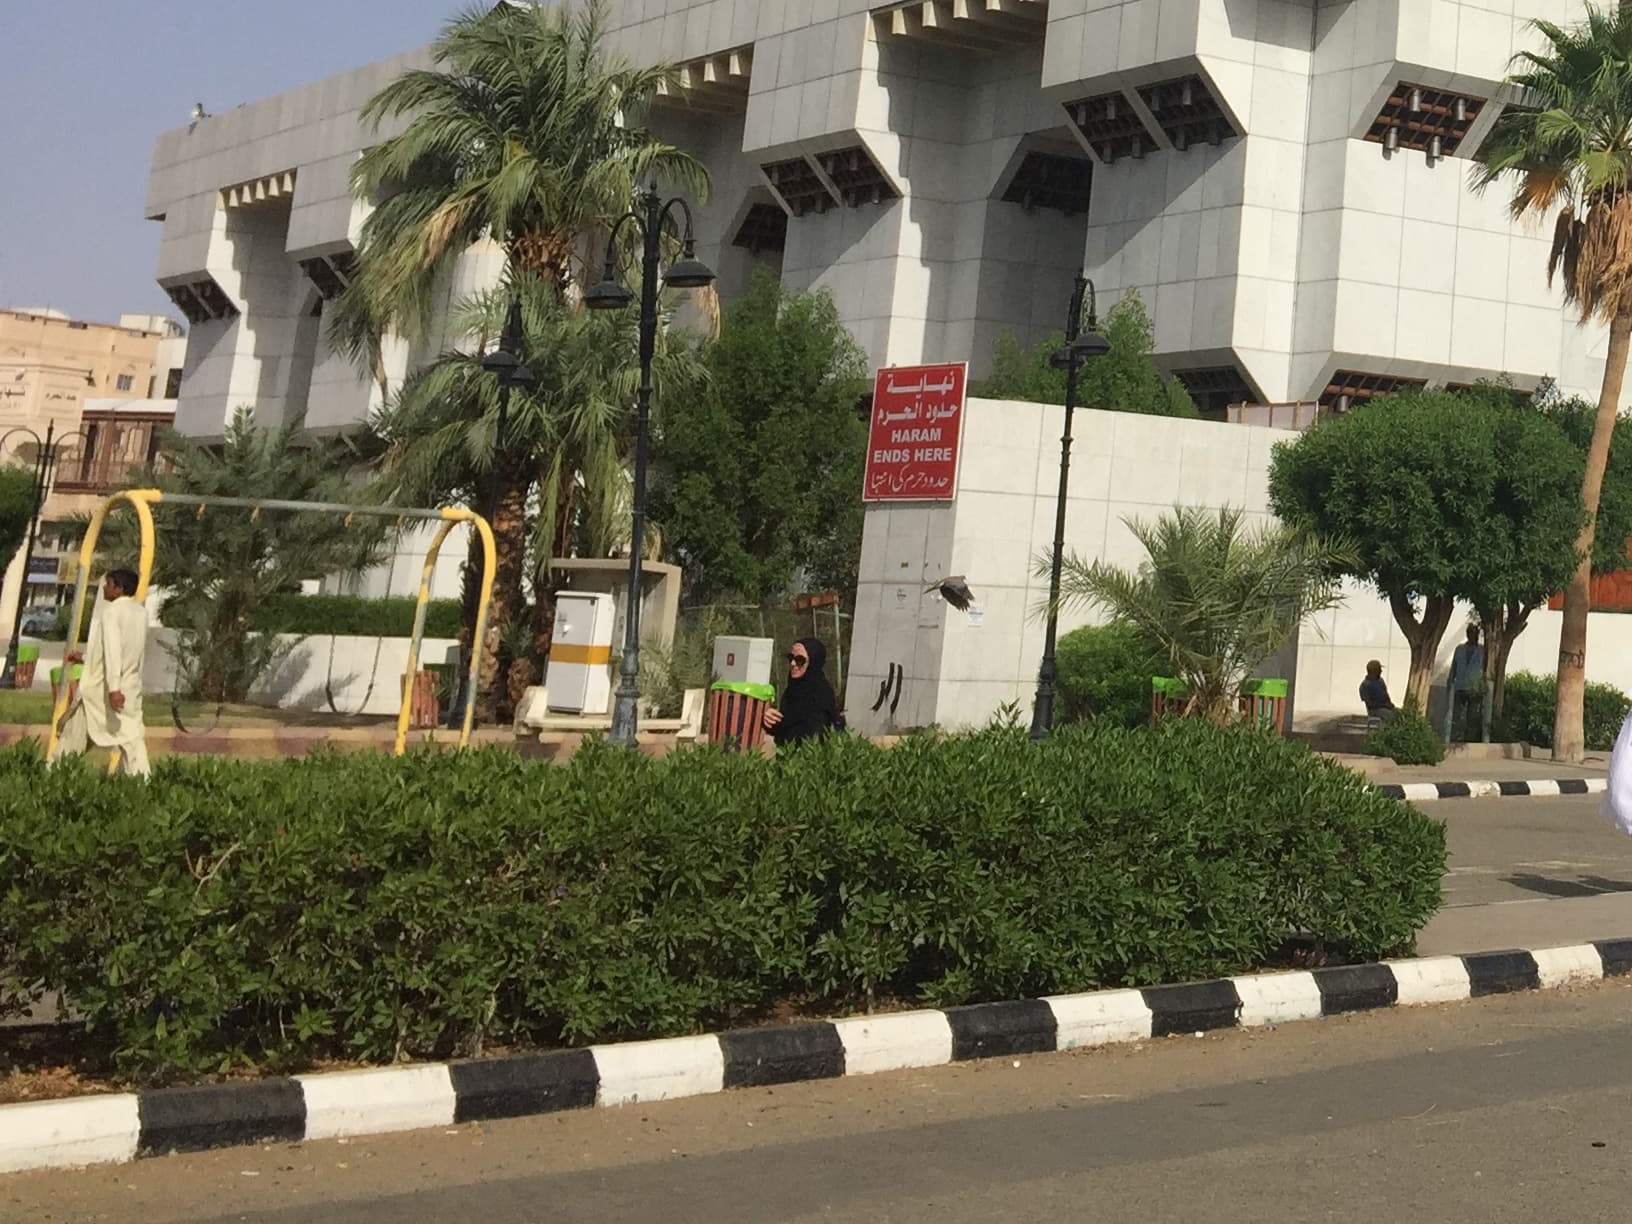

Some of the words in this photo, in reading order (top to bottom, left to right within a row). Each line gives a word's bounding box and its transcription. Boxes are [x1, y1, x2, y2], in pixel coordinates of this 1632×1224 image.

[887, 371, 955, 399] نهاية
[877, 401, 922, 426] الحرم
[926, 401, 958, 423] حدود
[891, 428, 942, 443] HARAM
[873, 449, 910, 463] ENDS
[914, 448, 952, 461] HERE
